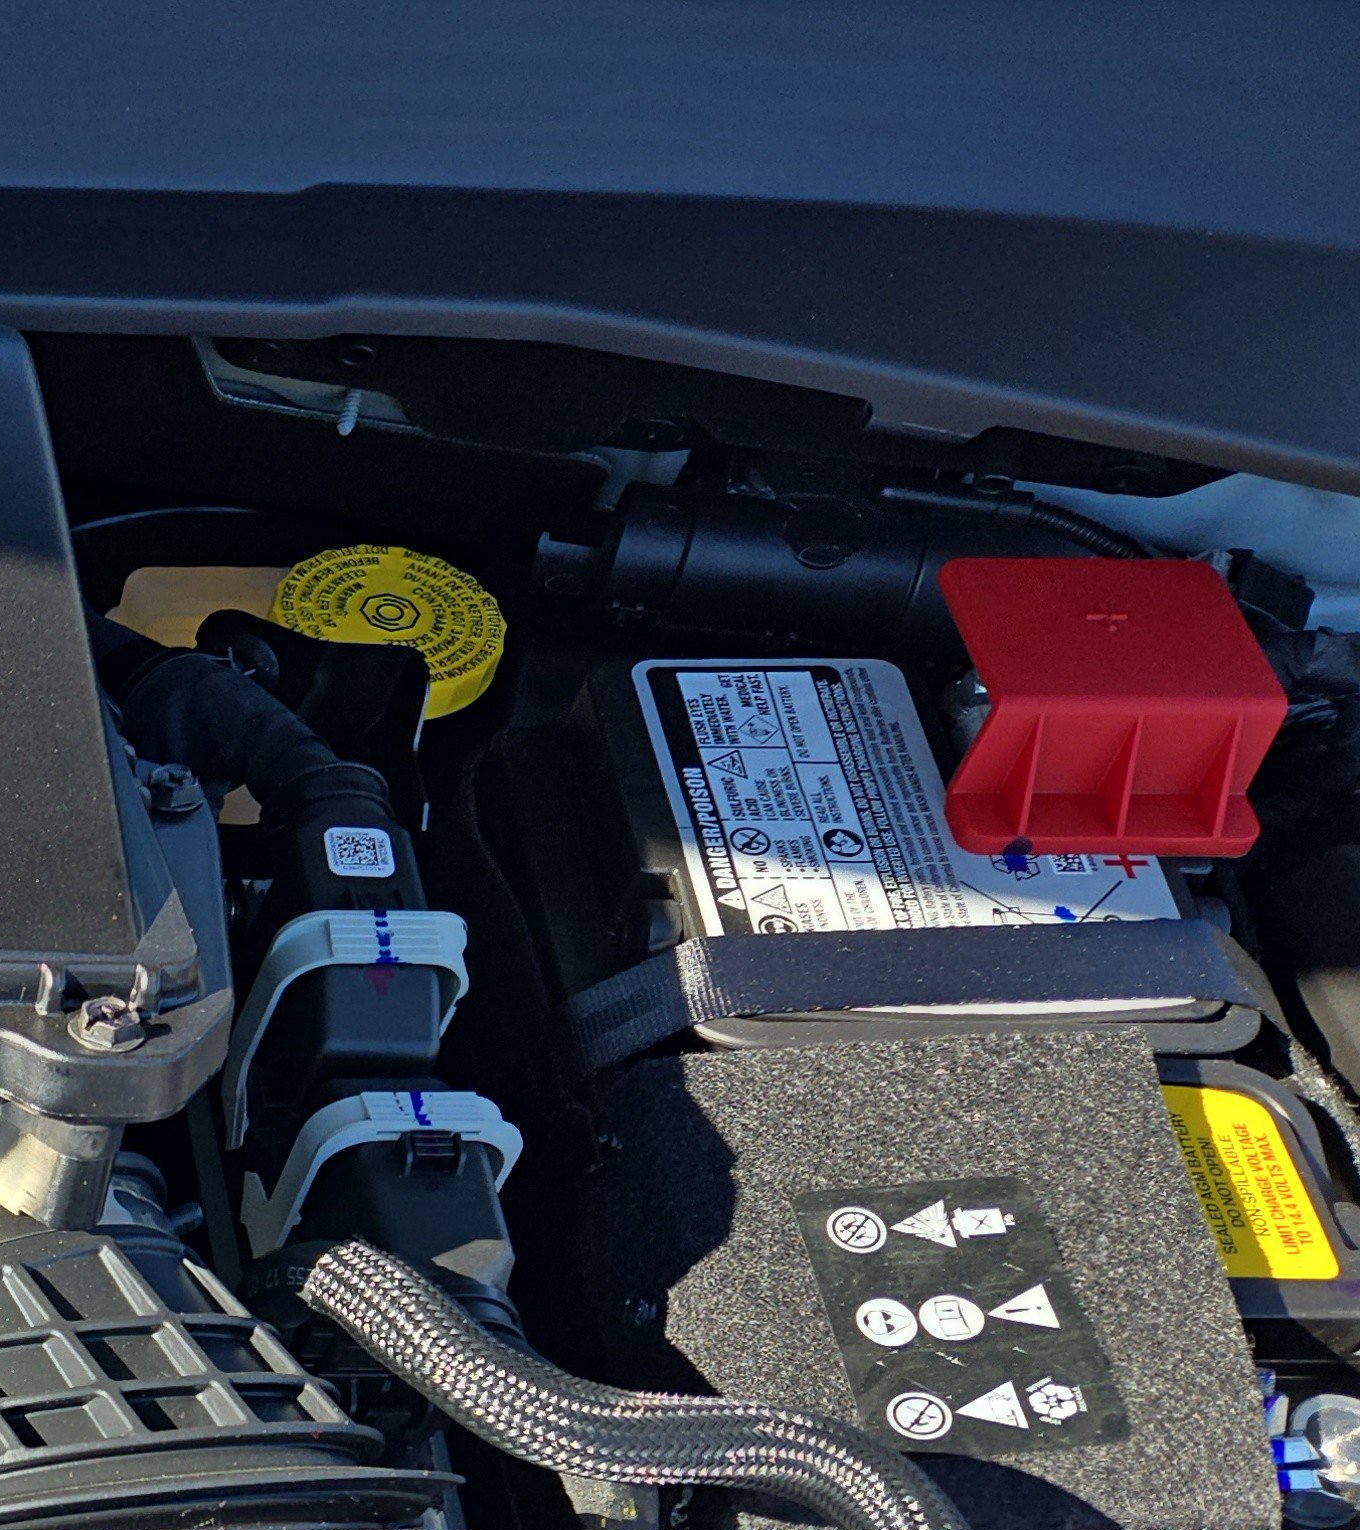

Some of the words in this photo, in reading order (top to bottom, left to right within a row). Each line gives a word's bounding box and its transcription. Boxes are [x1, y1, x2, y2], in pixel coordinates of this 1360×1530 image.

[717, 675, 733, 688] GET
[733, 674, 753, 707] MEDICAL
[686, 698, 704, 718] EYES
[700, 693, 726, 745] IMMEDIATELY
[753, 695, 771, 716] HELP
[693, 720, 711, 745] FLUSH
[723, 724, 741, 745] WITH
[721, 777, 747, 818] SULFURIC
[744, 797, 761, 818] ACID
[682, 767, 737, 889] DANGER/POISON
[753, 860, 769, 873] NO
[1168, 1111, 1201, 1168] BATTERY
[1232, 1122, 1264, 1172] VOLTAGE
[1197, 1137, 1223, 1177] OPEN!
[1191, 1171, 1215, 1201] AGM
[1214, 1180, 1236, 1207] NOT
[1217, 1134, 1271, 1237] NON-SPILLABLE
[1267, 1164, 1294, 1200] VOLTS
[1254, 1176, 1286, 1221] CHARGE
[1206, 1203, 1237, 1255] SEALED
[1227, 1209, 1245, 1228] DO
[1284, 1203, 1307, 1226] 14.4
[1273, 1224, 1301, 1255] LIMIT
[1297, 1230, 1314, 1246] TO
